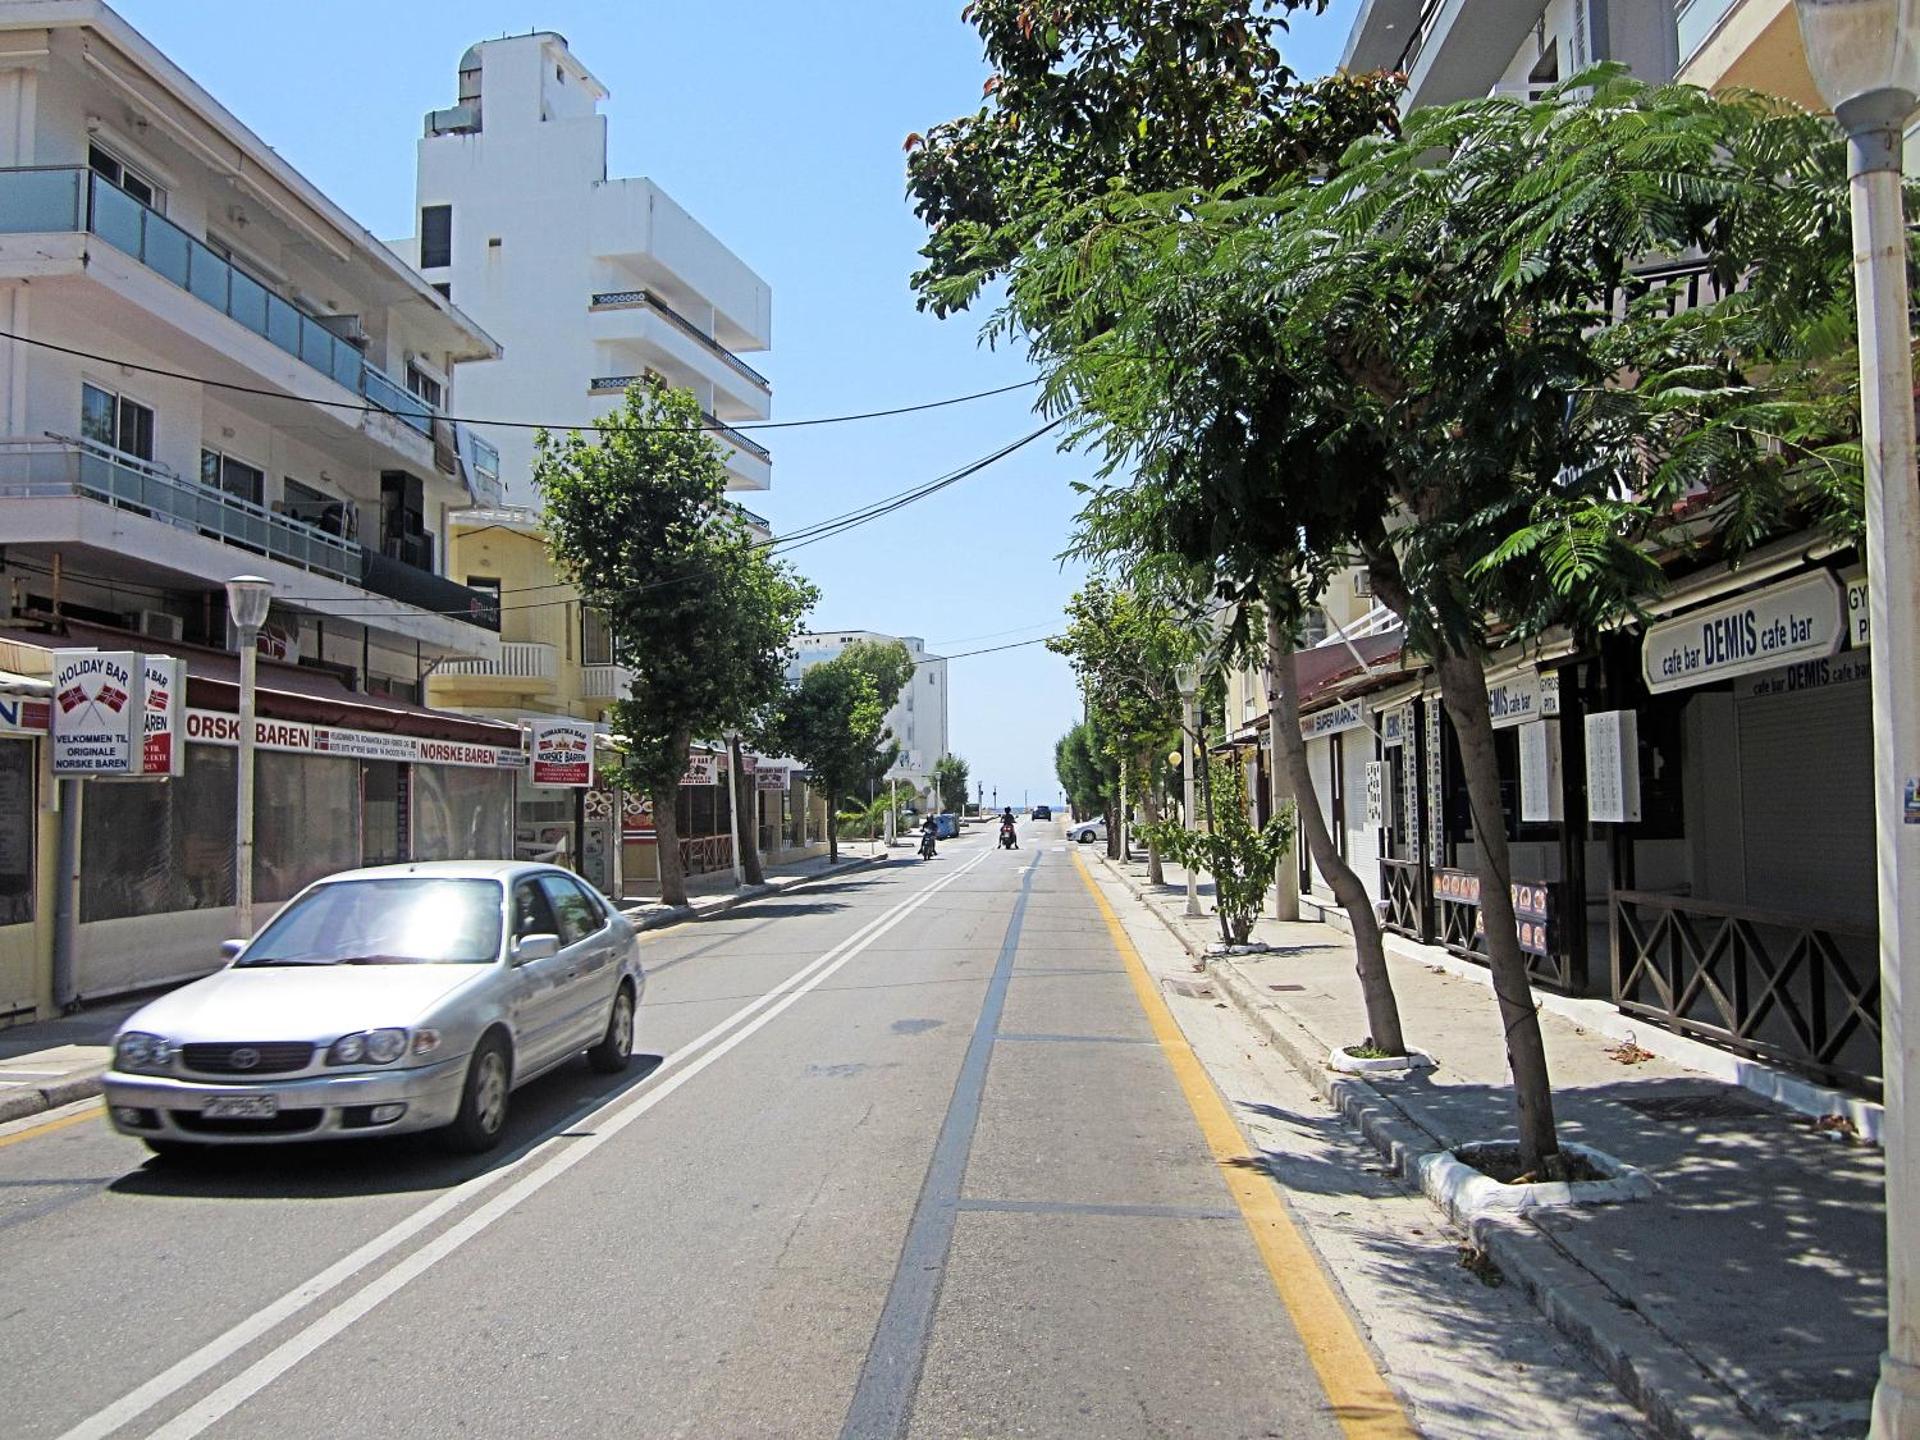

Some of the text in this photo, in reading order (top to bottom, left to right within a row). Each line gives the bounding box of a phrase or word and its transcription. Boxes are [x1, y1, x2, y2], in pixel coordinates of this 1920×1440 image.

[1849, 586, 1868, 610] GY
[1662, 609, 1813, 675] cafe bar DEMIS cafe bar
[58, 659, 128, 687] HOLIDAY BAR
[151, 670, 168, 688] BAR
[1752, 679, 1770, 695] cafe
[1787, 658, 1830, 691] DEMIS
[1832, 664, 1852, 681] cafe
[1488, 686, 1508, 717] EMIS
[144, 713, 168, 733] AREN
[186, 714, 310, 748] ORSK BAREN
[1316, 711, 1334, 732] SUPER
[56, 734, 128, 744] VELKOMMEN TIL
[67, 747, 116, 757] ORIGINALE
[420, 743, 463, 761] NORSKE
[464, 747, 495, 764] BAREN
[538, 751, 563, 763] NORSKE
[564, 751, 587, 763] BAREN
[56, 759, 128, 769] NORSKE BAREN
